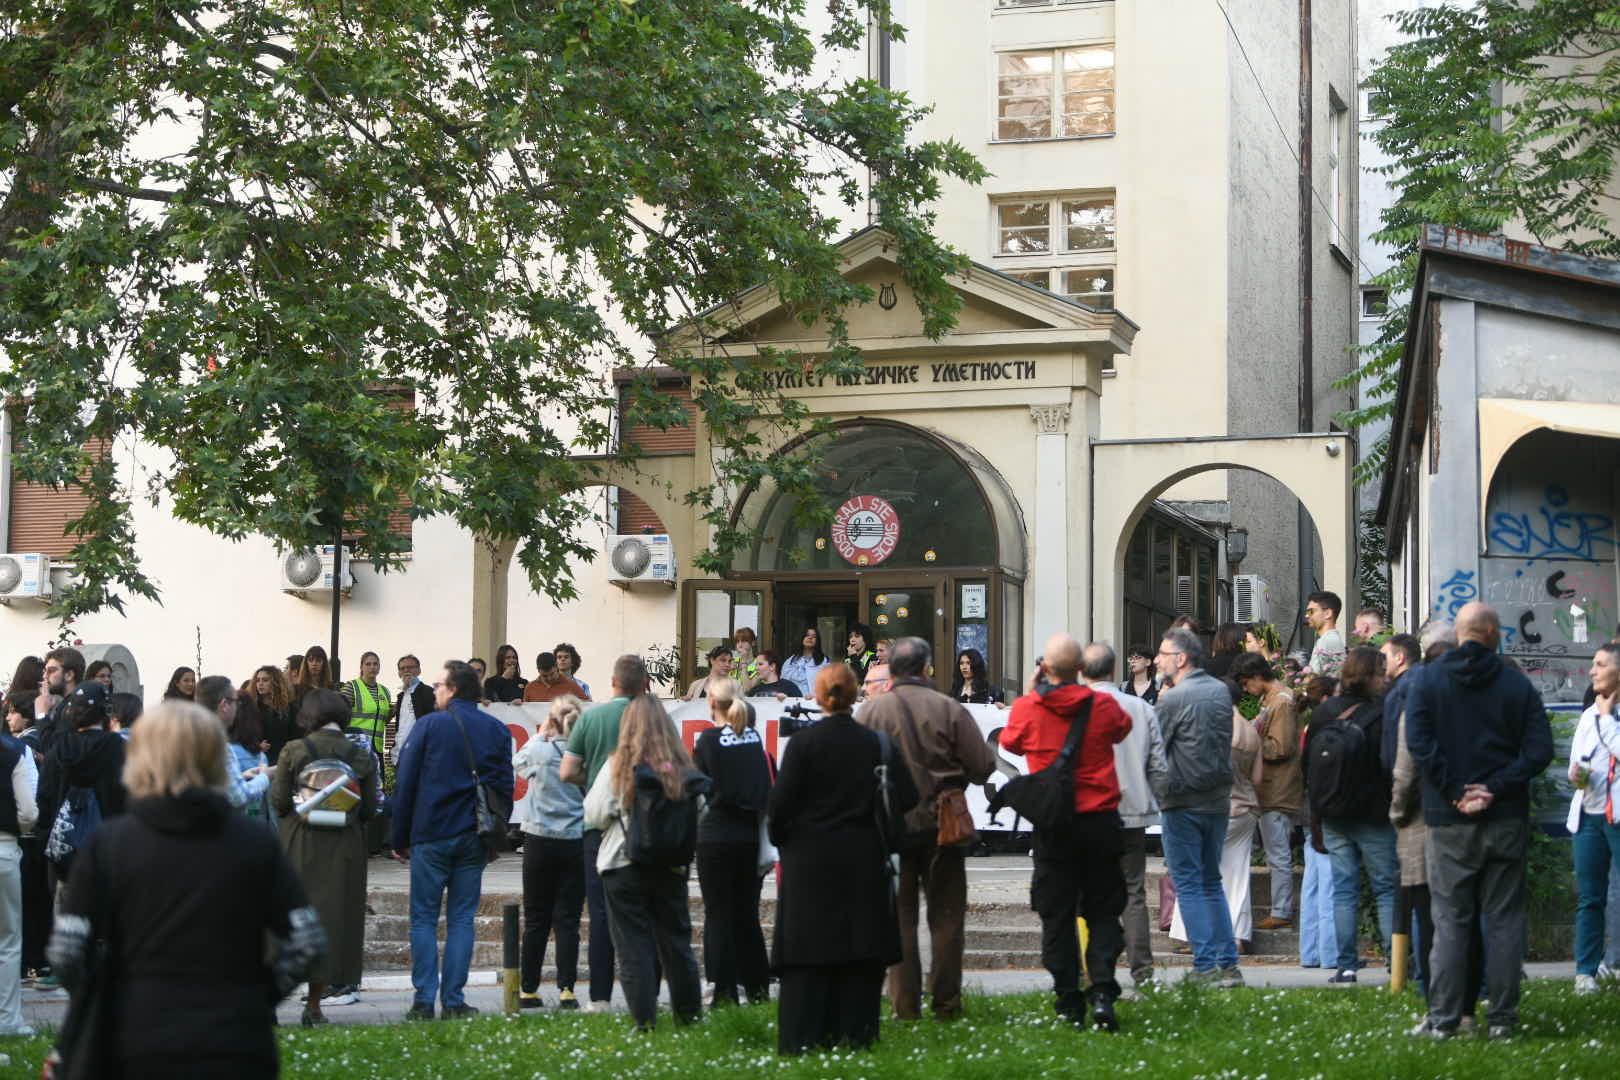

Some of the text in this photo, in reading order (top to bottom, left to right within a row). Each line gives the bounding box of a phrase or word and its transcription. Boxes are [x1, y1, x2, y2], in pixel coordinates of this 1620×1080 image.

[735, 366, 825, 390] КУЛТЕТ
[931, 360, 1036, 383] УМЕТНОСТИ
[869, 497, 895, 521] STE
[719, 731, 760, 747] adas
